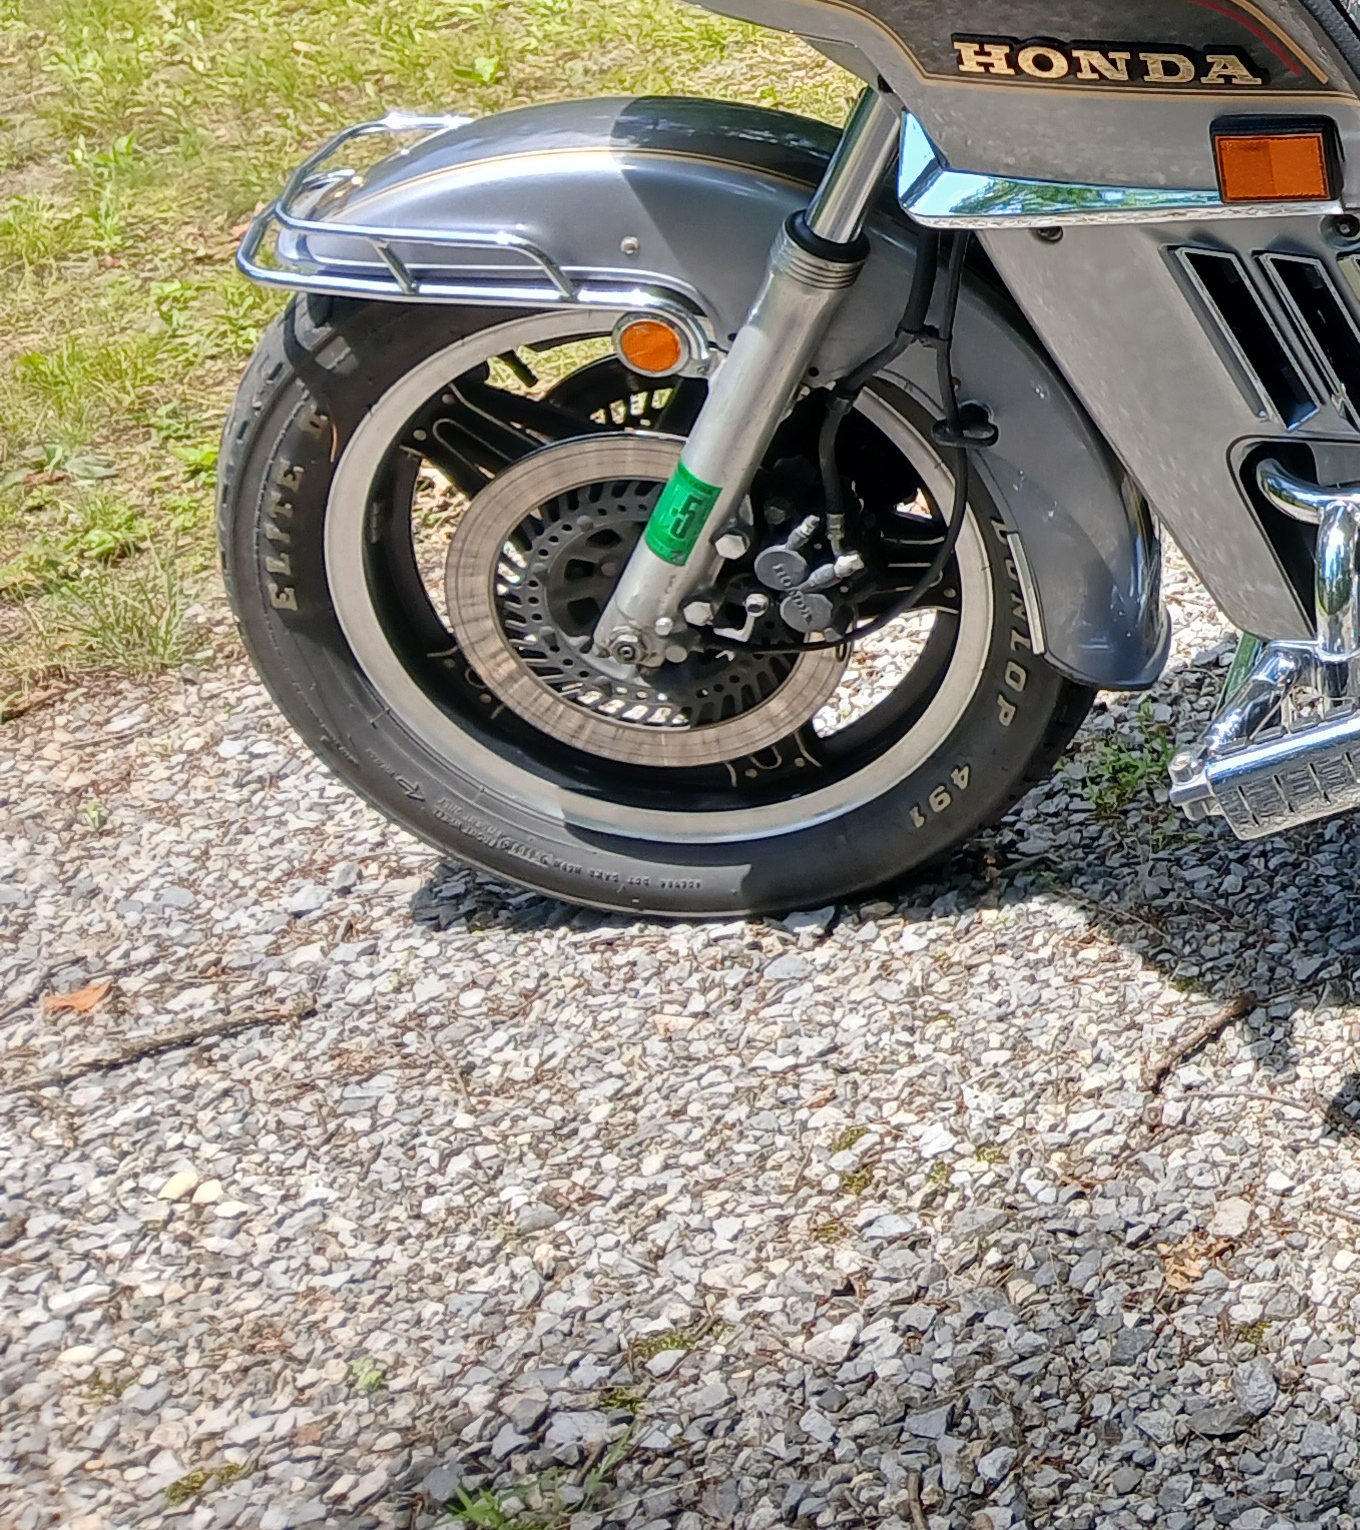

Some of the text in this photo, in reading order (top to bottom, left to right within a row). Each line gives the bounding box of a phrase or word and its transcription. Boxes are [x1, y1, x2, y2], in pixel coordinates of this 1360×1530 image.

[952, 37, 1264, 85] HONDA
[265, 458, 304, 612] ELITE
[909, 765, 970, 828] 491
